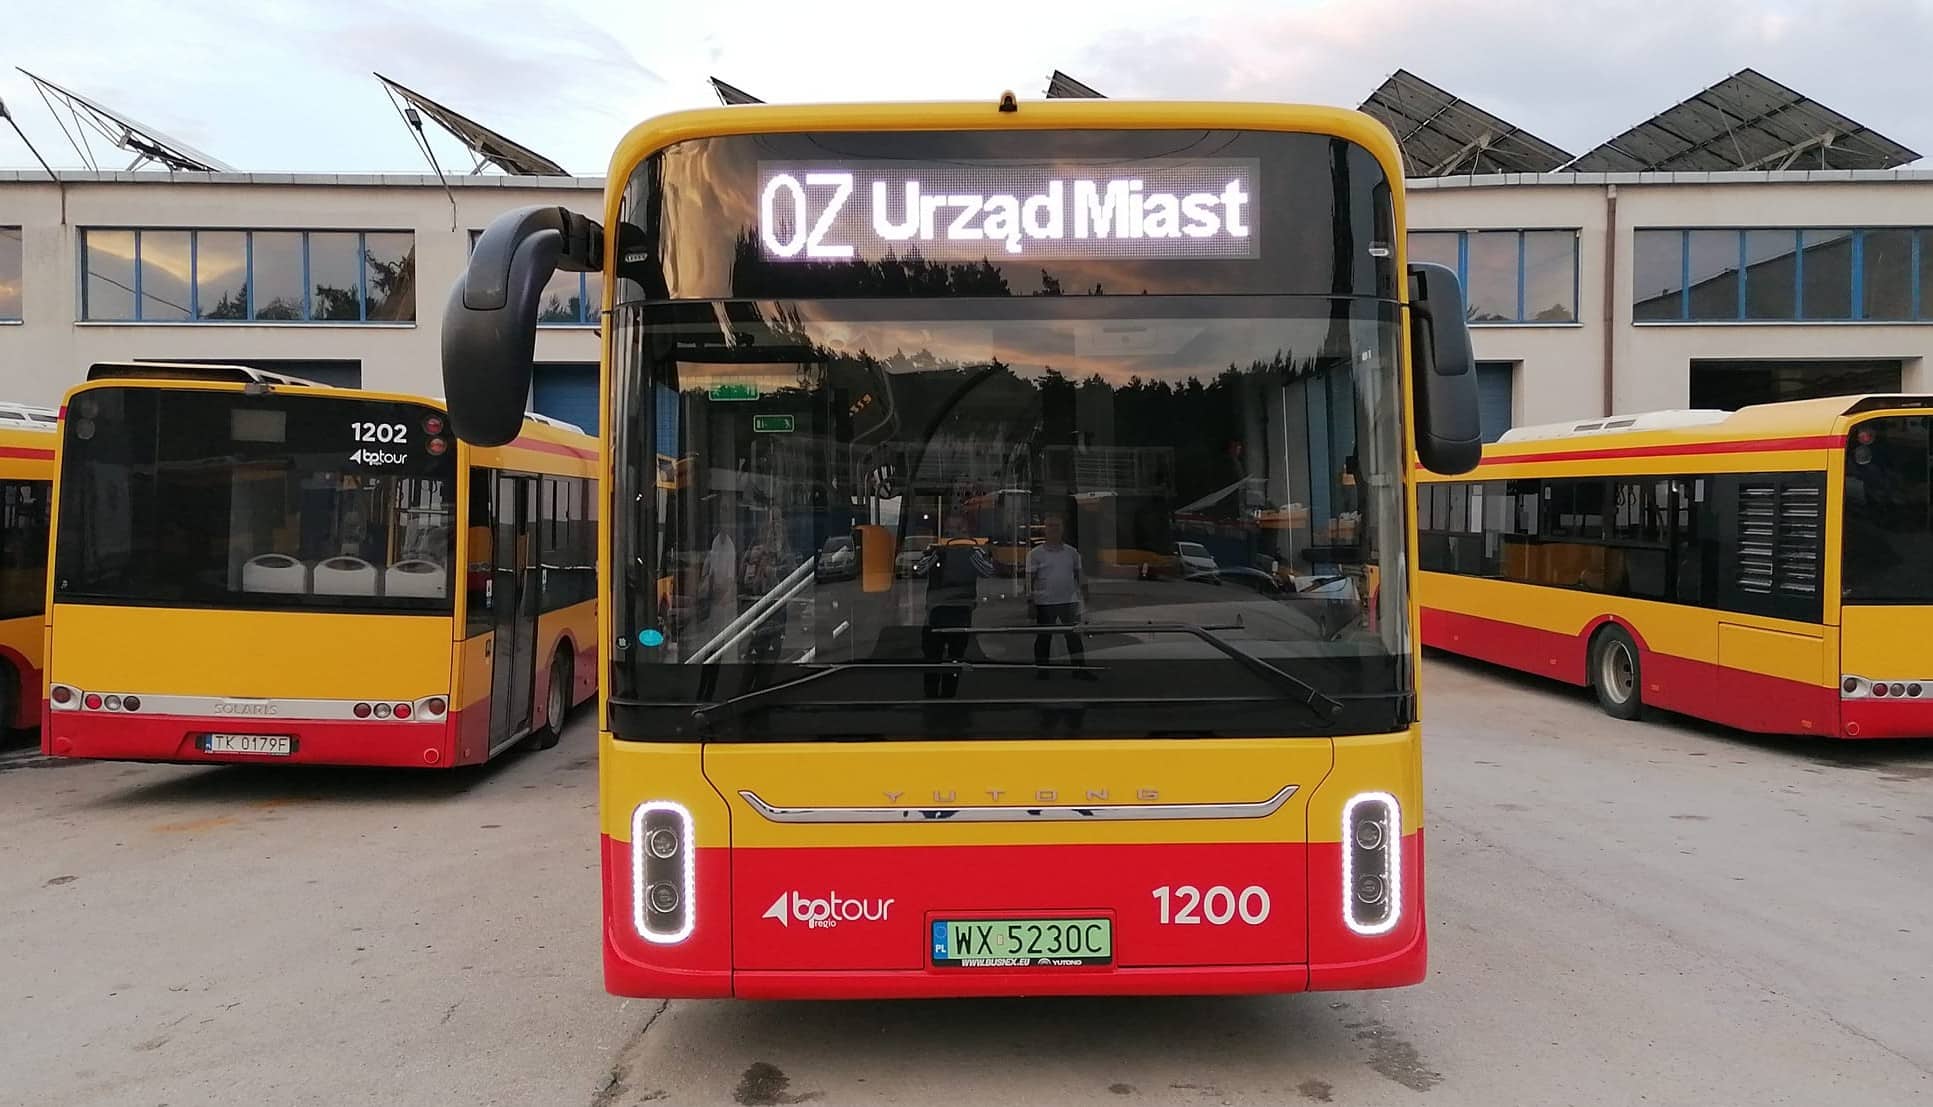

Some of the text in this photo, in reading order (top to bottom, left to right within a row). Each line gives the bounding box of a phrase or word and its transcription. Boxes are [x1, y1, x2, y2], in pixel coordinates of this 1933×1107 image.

[872, 179, 1063, 253] Urząd
[1074, 179, 1248, 239] Miast
[351, 422, 407, 443] 1202
[214, 703, 279, 715] SOLARIS
[216, 736, 234, 750] TK
[242, 736, 288, 752] 0179F
[883, 788, 1160, 802] YUTONG
[792, 890, 895, 928] bptour
[1152, 885, 1271, 925] 1200
[814, 918, 837, 929] regio
[935, 924, 1102, 955] PL WX 5230C
